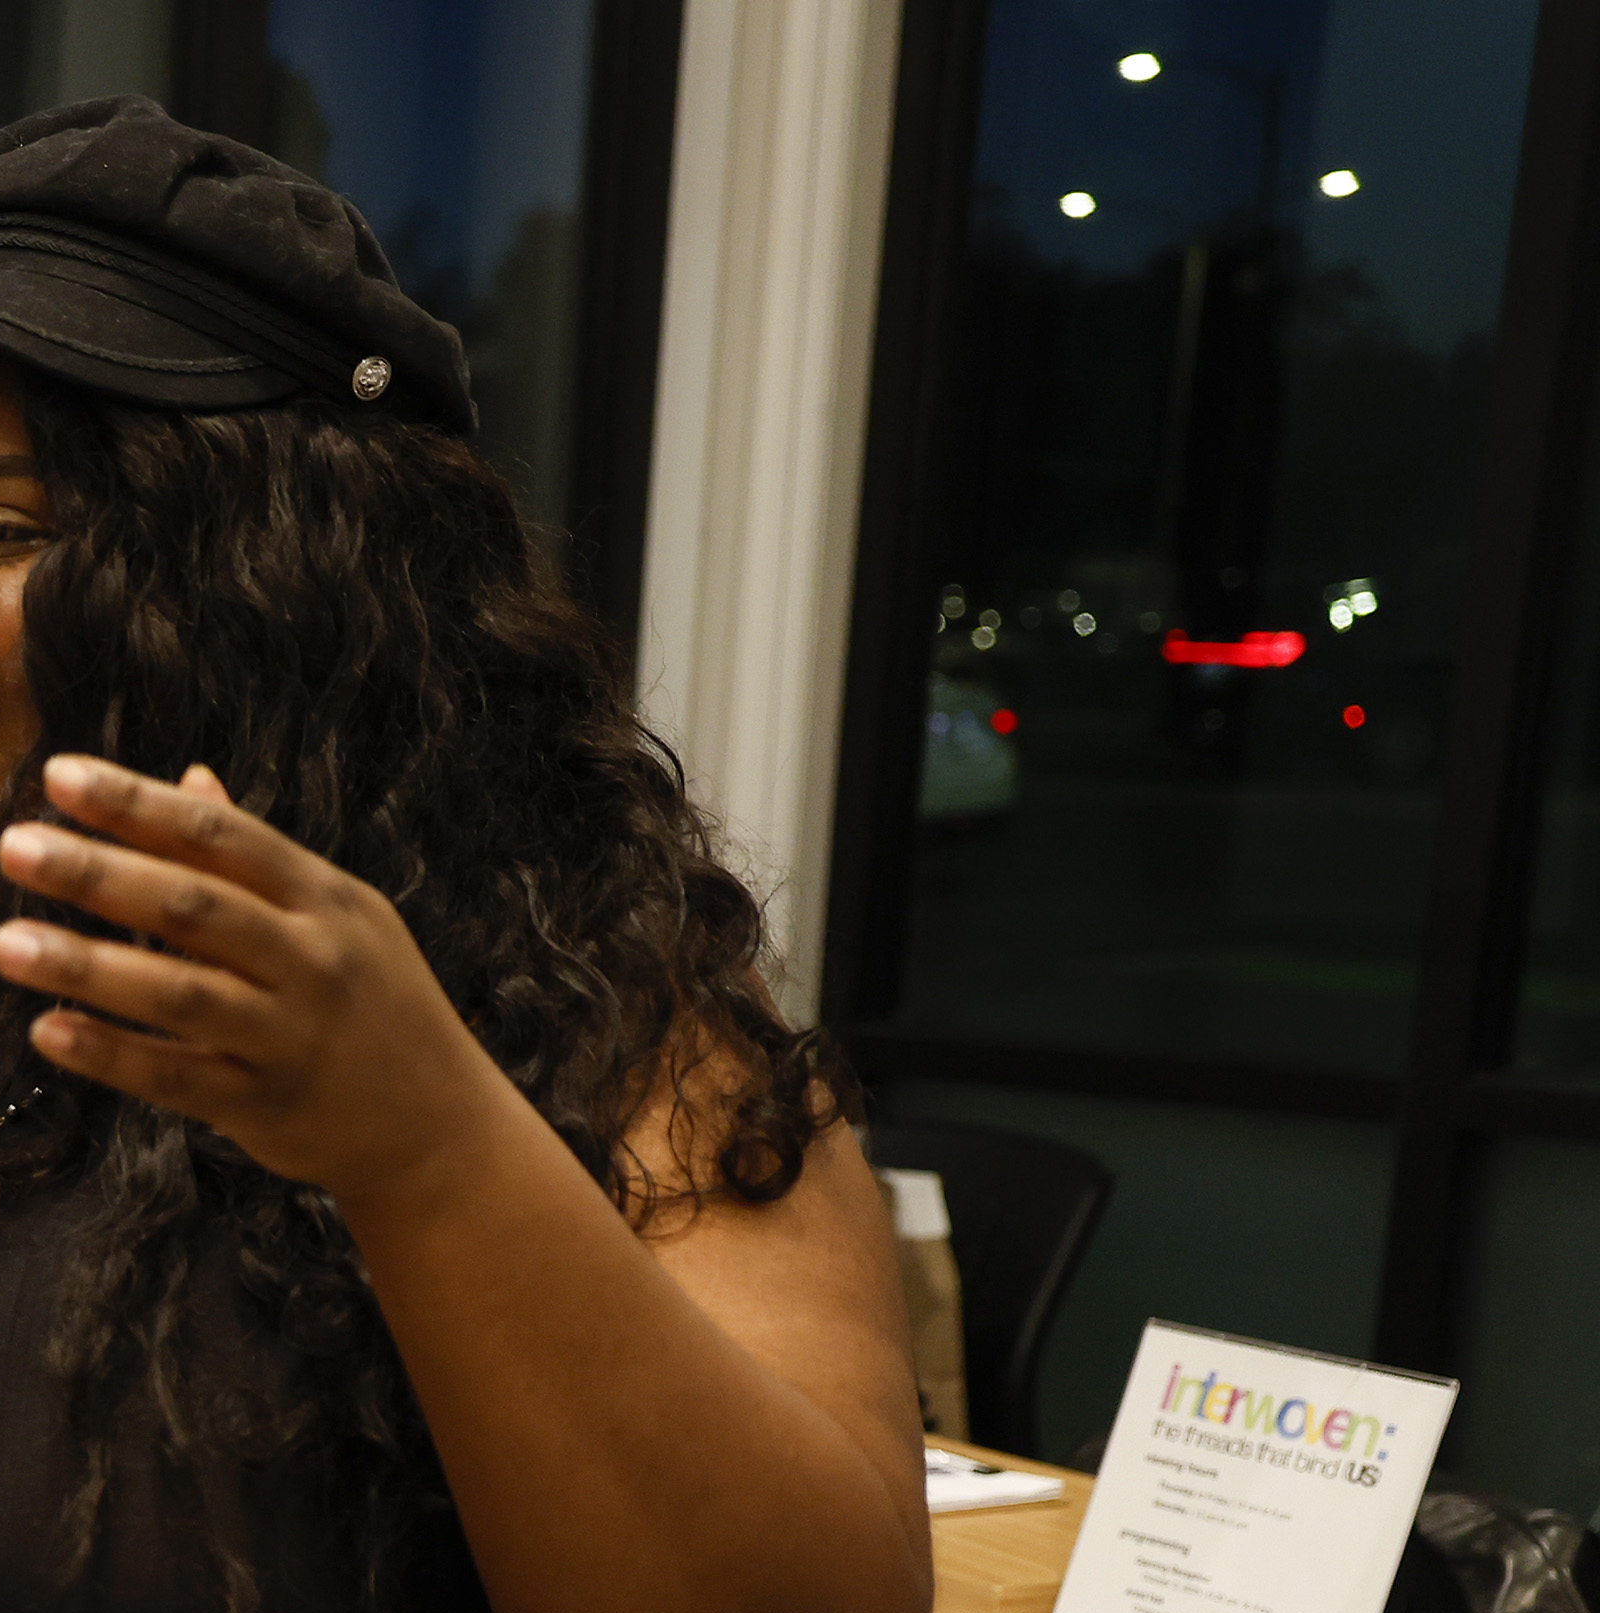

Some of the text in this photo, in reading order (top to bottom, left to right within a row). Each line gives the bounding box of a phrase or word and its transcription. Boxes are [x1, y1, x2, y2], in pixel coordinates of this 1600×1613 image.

[1154, 1419, 1181, 1442] the
[1184, 1424, 1252, 1459] threads
[1256, 1440, 1293, 1465] that
[1295, 1450, 1341, 1480] bind
[1159, 1363, 1398, 1461] interwoven:
